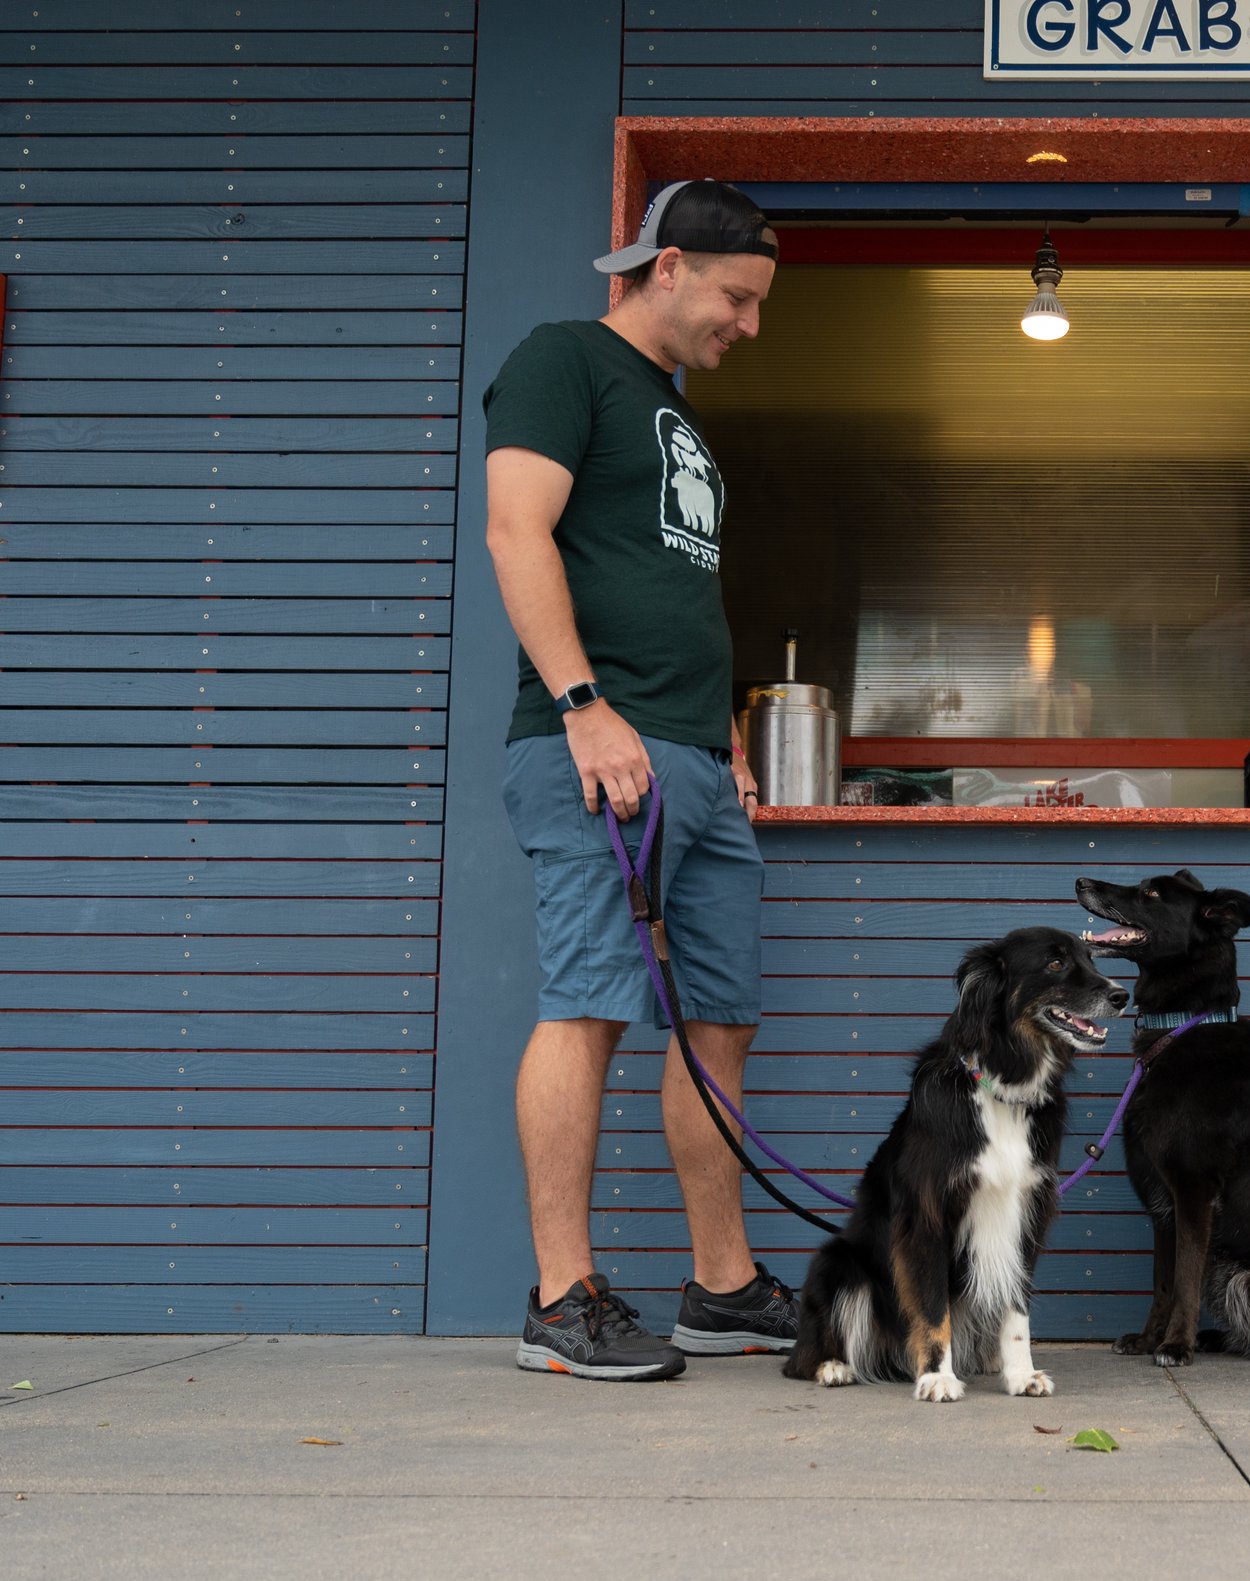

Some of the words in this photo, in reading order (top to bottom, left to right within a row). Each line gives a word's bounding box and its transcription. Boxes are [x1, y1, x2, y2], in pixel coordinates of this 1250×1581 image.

[1026, 0, 1242, 54] GRAB
[661, 531, 699, 556] WILD
[700, 546, 720, 574] STA
